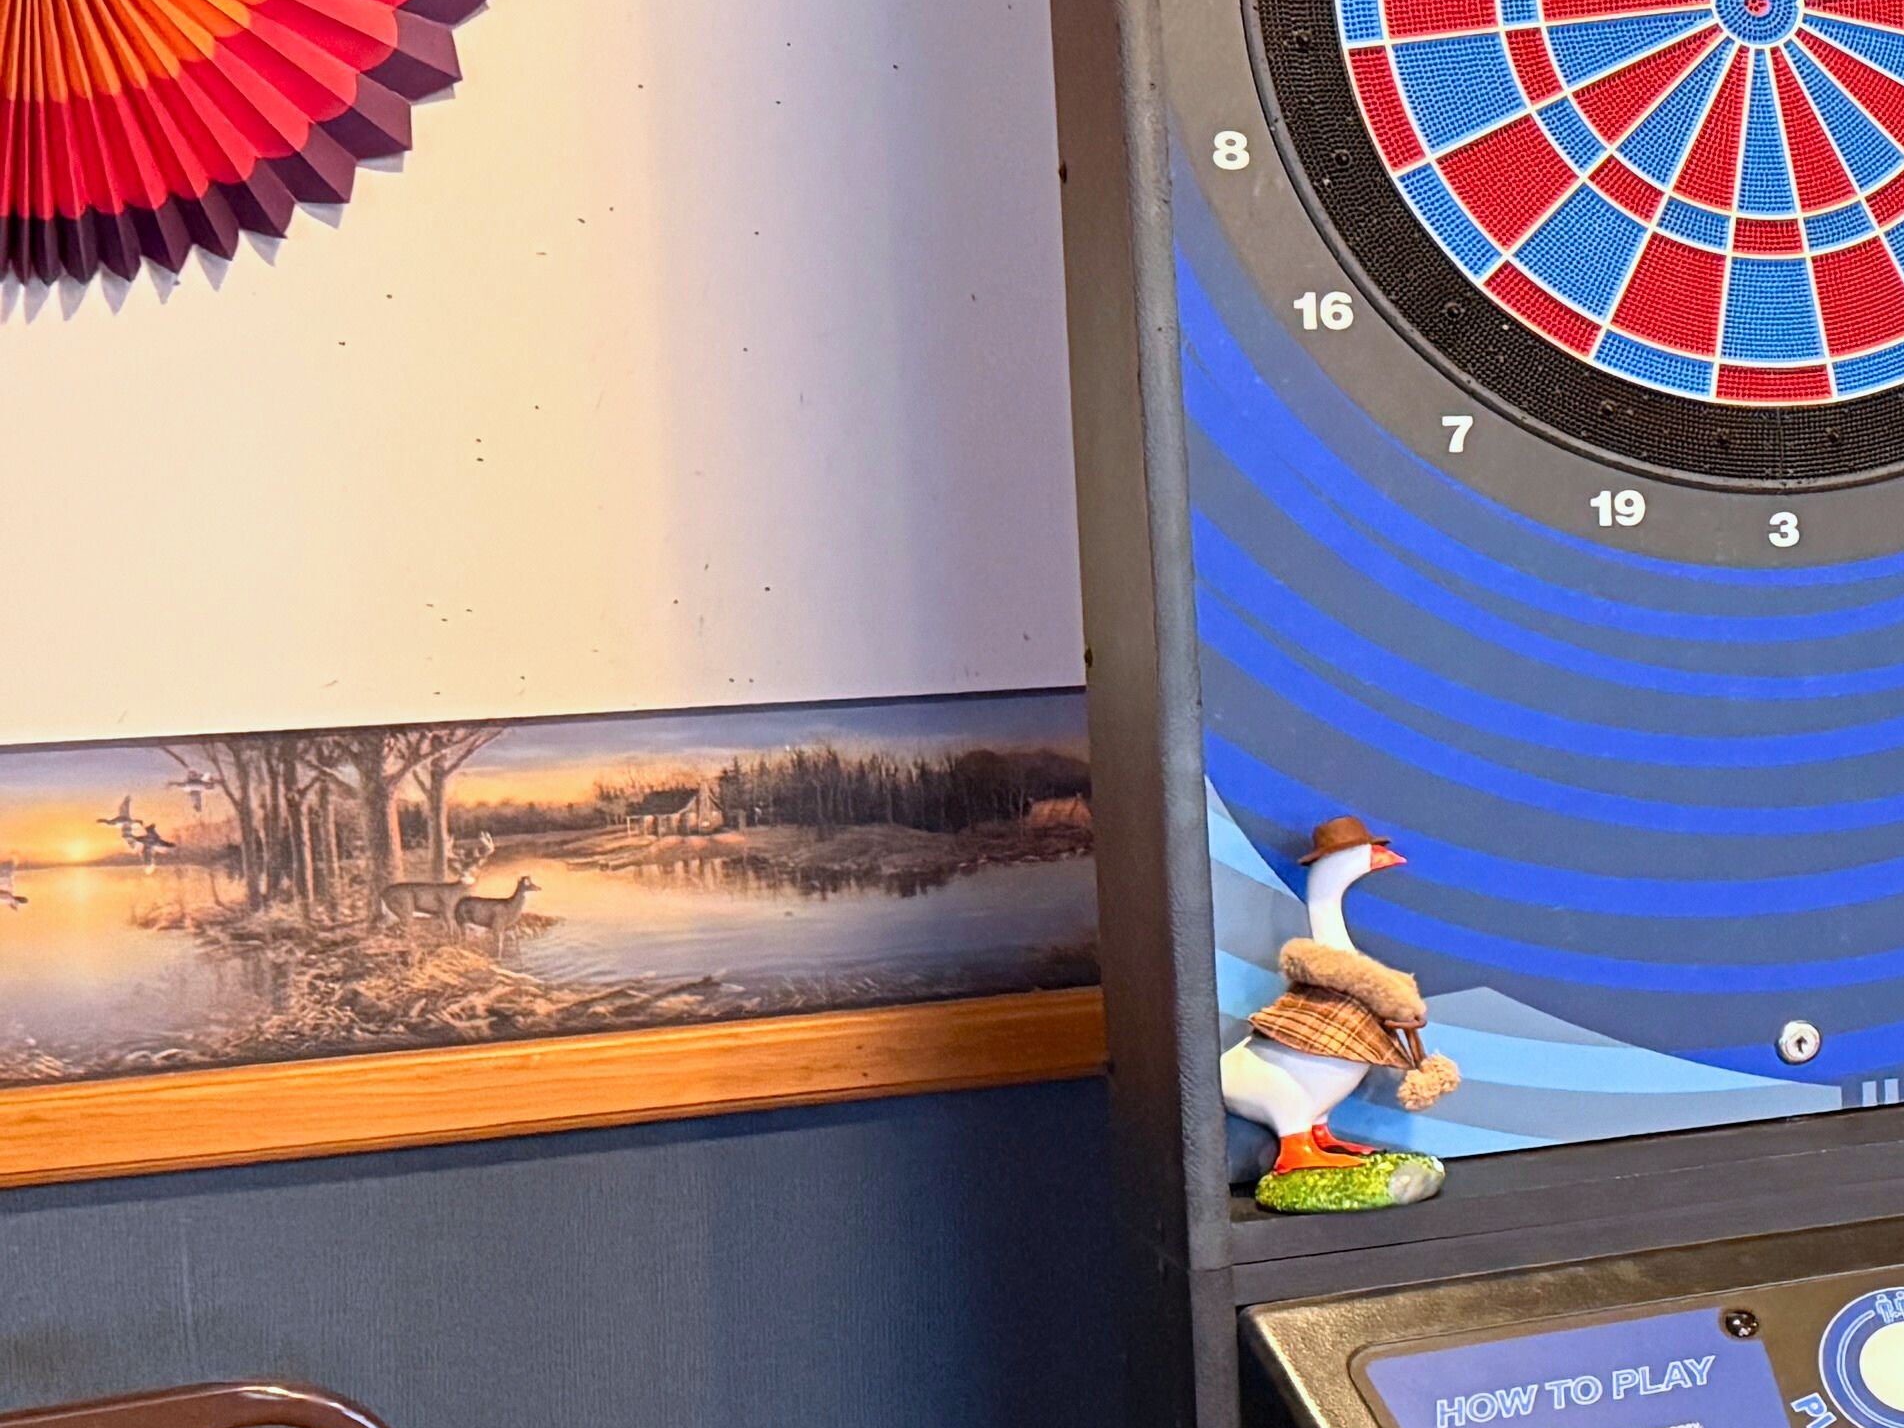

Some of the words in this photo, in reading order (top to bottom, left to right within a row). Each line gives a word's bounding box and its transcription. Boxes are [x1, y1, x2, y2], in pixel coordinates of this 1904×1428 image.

[1212, 131, 1249, 171] 8
[1292, 292, 1354, 332] 16
[1441, 415, 1475, 454] 7
[1590, 491, 1647, 532] 19
[1768, 513, 1800, 550] 3
[1436, 1385, 1538, 1428] HOW
[1545, 1376, 1603, 1409] TO
[1613, 1356, 1715, 1400] PLAY
